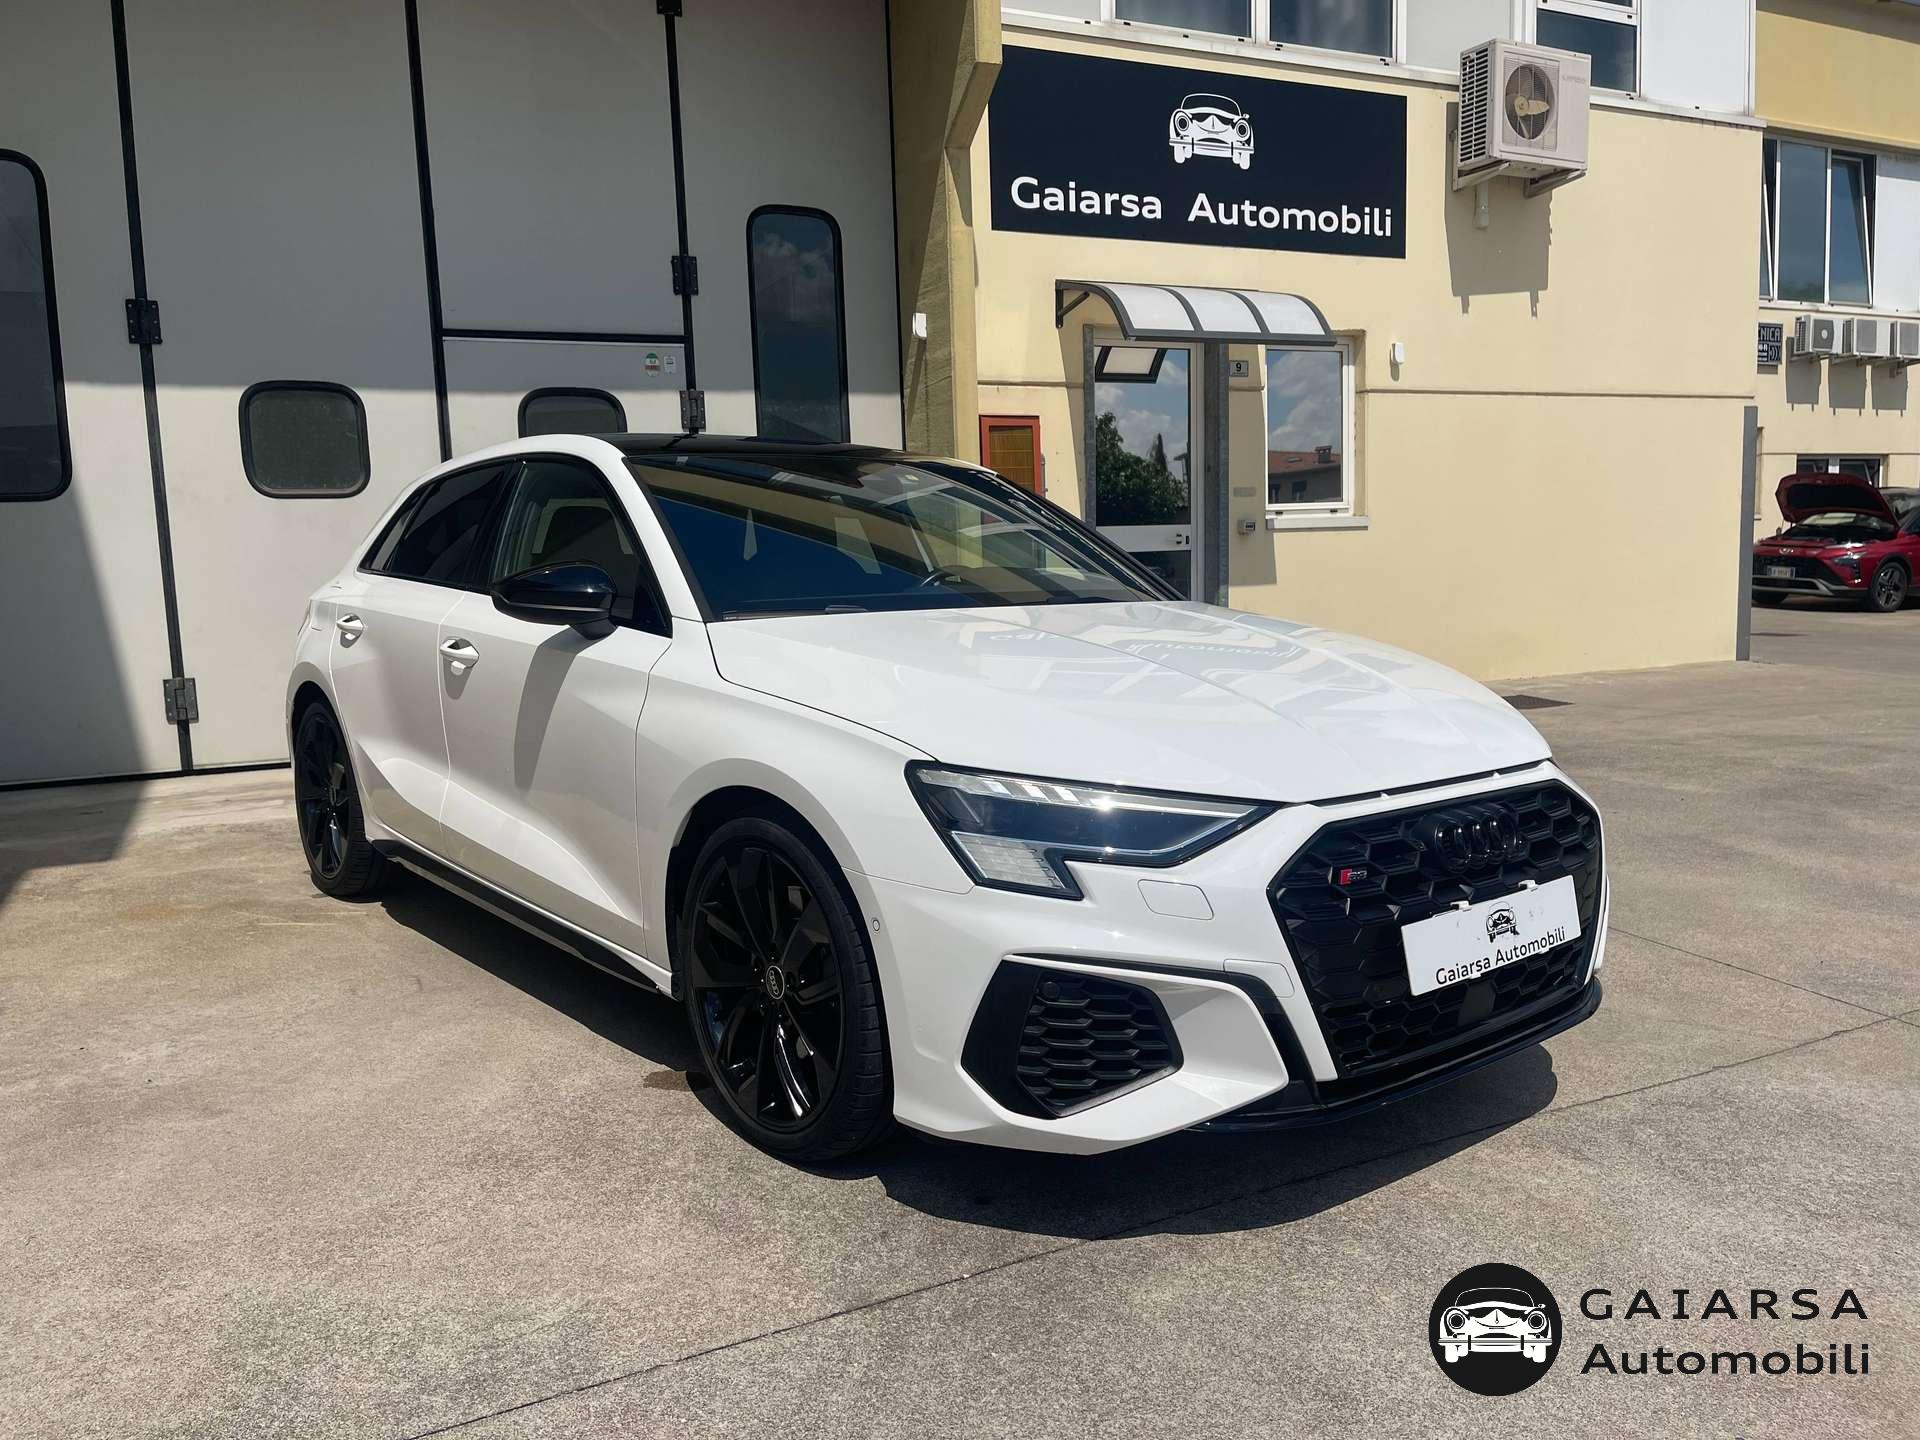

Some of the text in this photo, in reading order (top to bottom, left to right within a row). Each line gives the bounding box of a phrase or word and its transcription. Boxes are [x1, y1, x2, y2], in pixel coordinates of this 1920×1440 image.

[1010, 176, 1393, 237] Gaiarsa Automobili
[1759, 327, 1781, 342] NICA
[1235, 362, 1242, 372] 9
[1435, 926, 1565, 985] Gaiarsa Automobili
